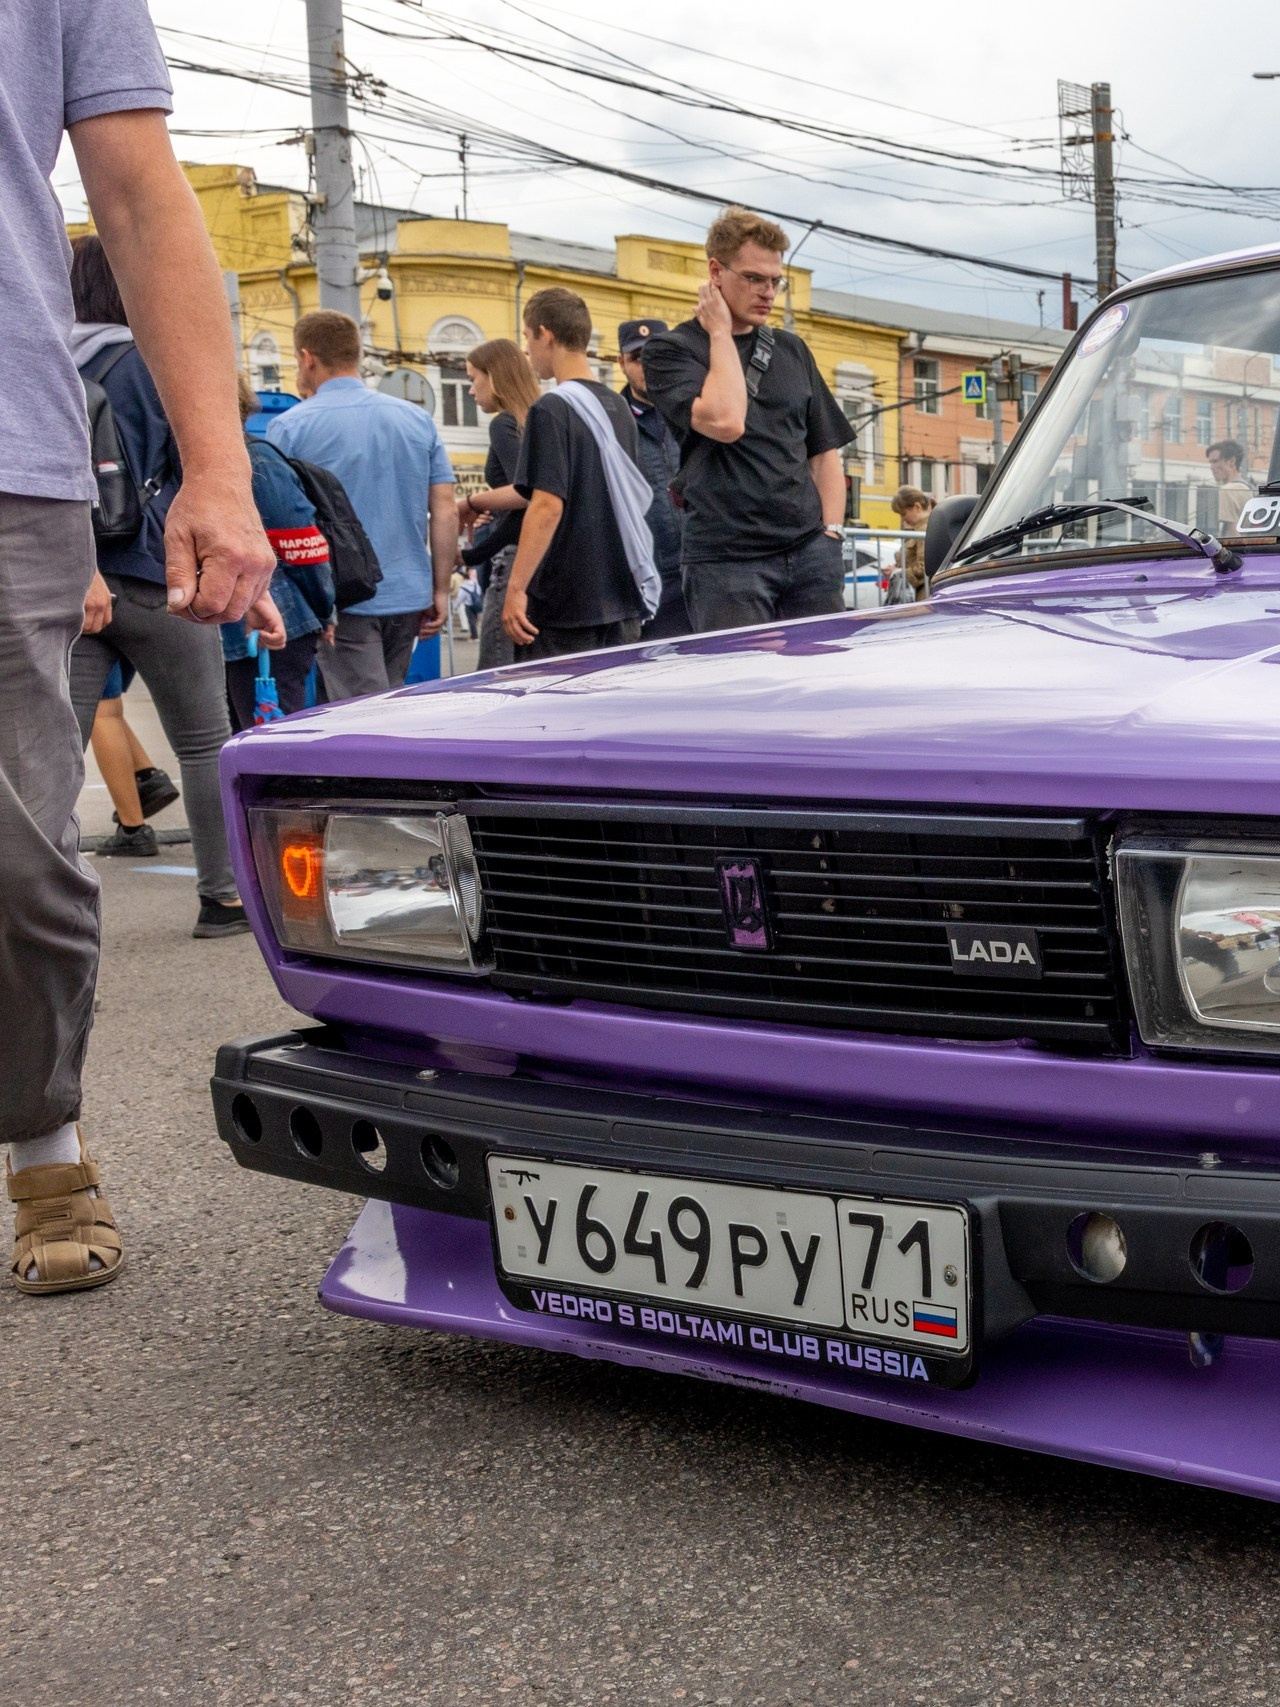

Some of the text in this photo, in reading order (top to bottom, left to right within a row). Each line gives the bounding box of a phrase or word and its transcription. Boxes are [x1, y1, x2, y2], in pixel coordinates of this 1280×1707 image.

[950, 938, 1037, 965] LADA
[848, 1212, 932, 1298] 71
[530, 1289, 930, 1382] VEDRO S BOLTAMI CLUB RUSSIA
[851, 1293, 911, 1328] RUS
